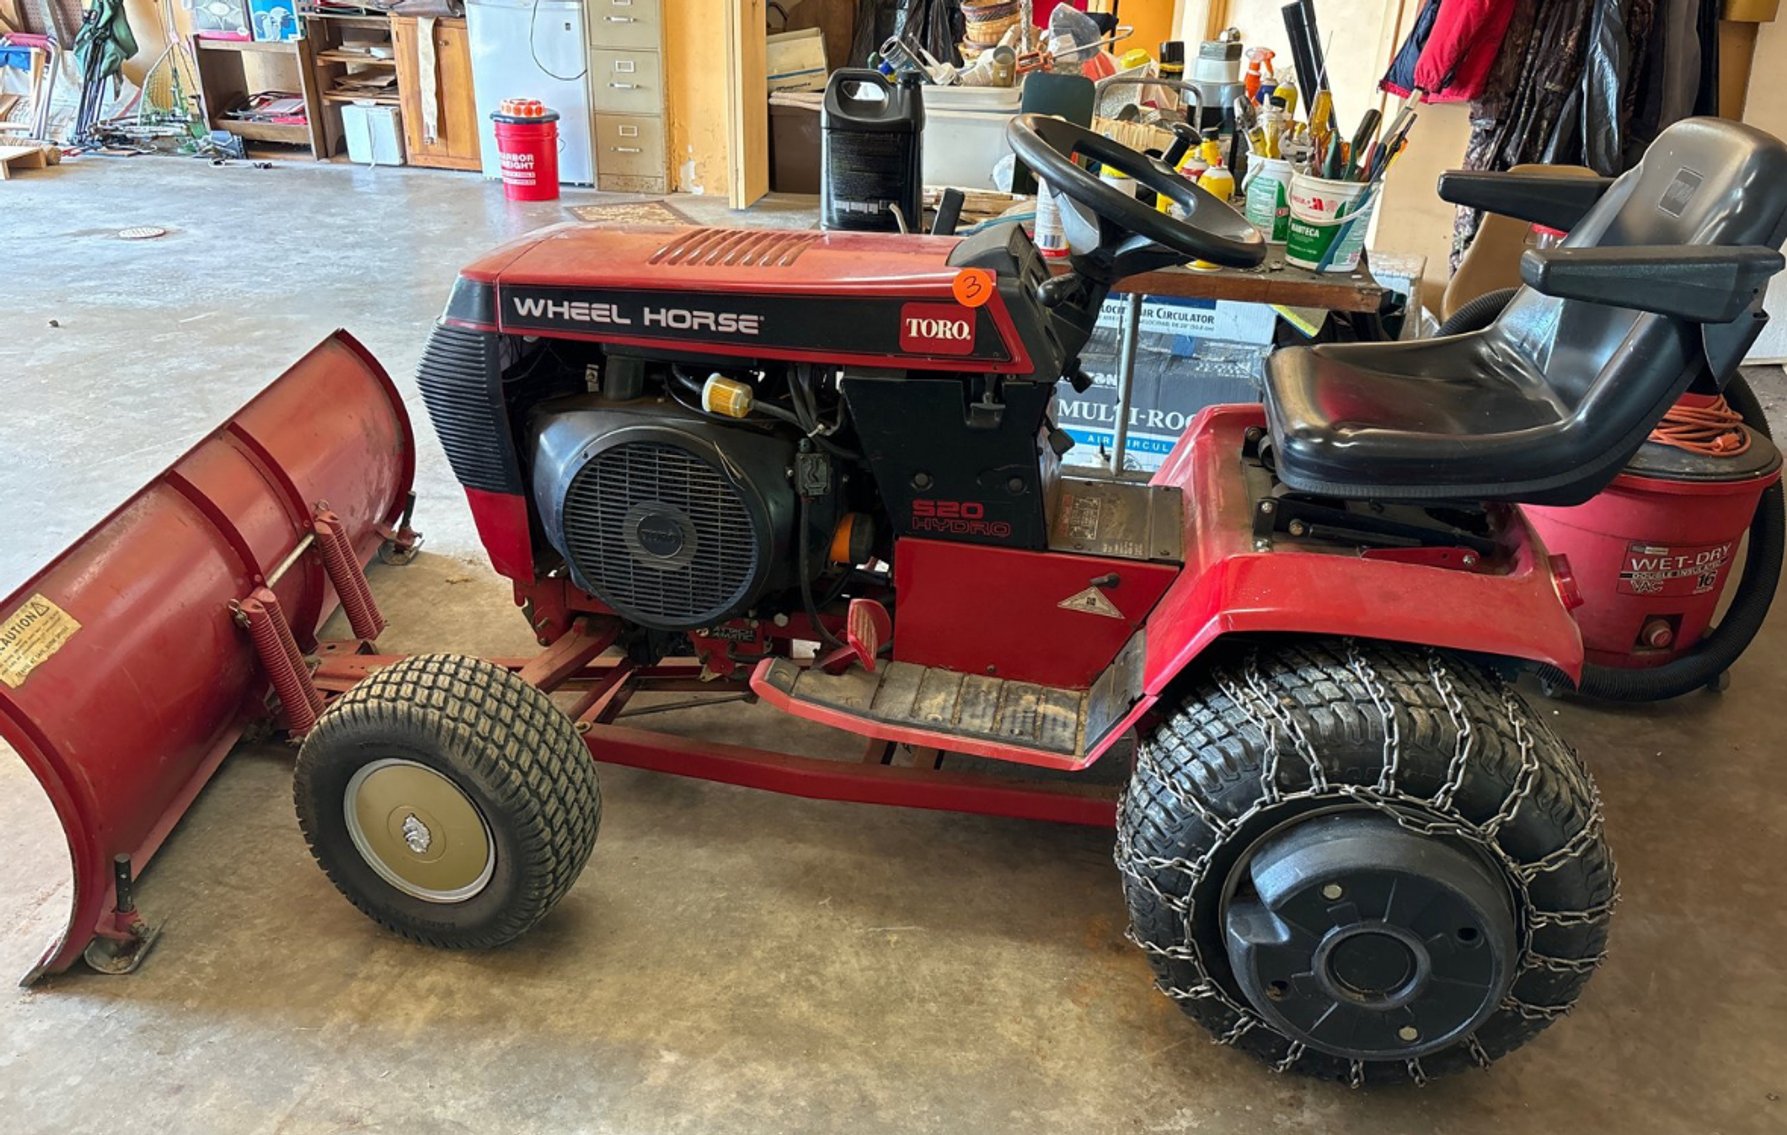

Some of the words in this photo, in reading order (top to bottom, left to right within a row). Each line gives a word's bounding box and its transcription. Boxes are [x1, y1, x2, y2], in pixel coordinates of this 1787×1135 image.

[963, 275, 982, 299] 3
[513, 297, 632, 325] WHEEL
[644, 307, 760, 335] HORSE
[1156, 307, 1216, 325] CIRCULATOR
[1057, 398, 1197, 431] MULI-RO
[1087, 434, 1111, 444] AIR
[1127, 438, 1169, 452] IRCUL
[912, 516, 1011, 538] HYDRO
[1631, 542, 1732, 571] WET-DRY
[1630, 580, 1664, 594] VAC
[1697, 570, 1717, 588] 16
